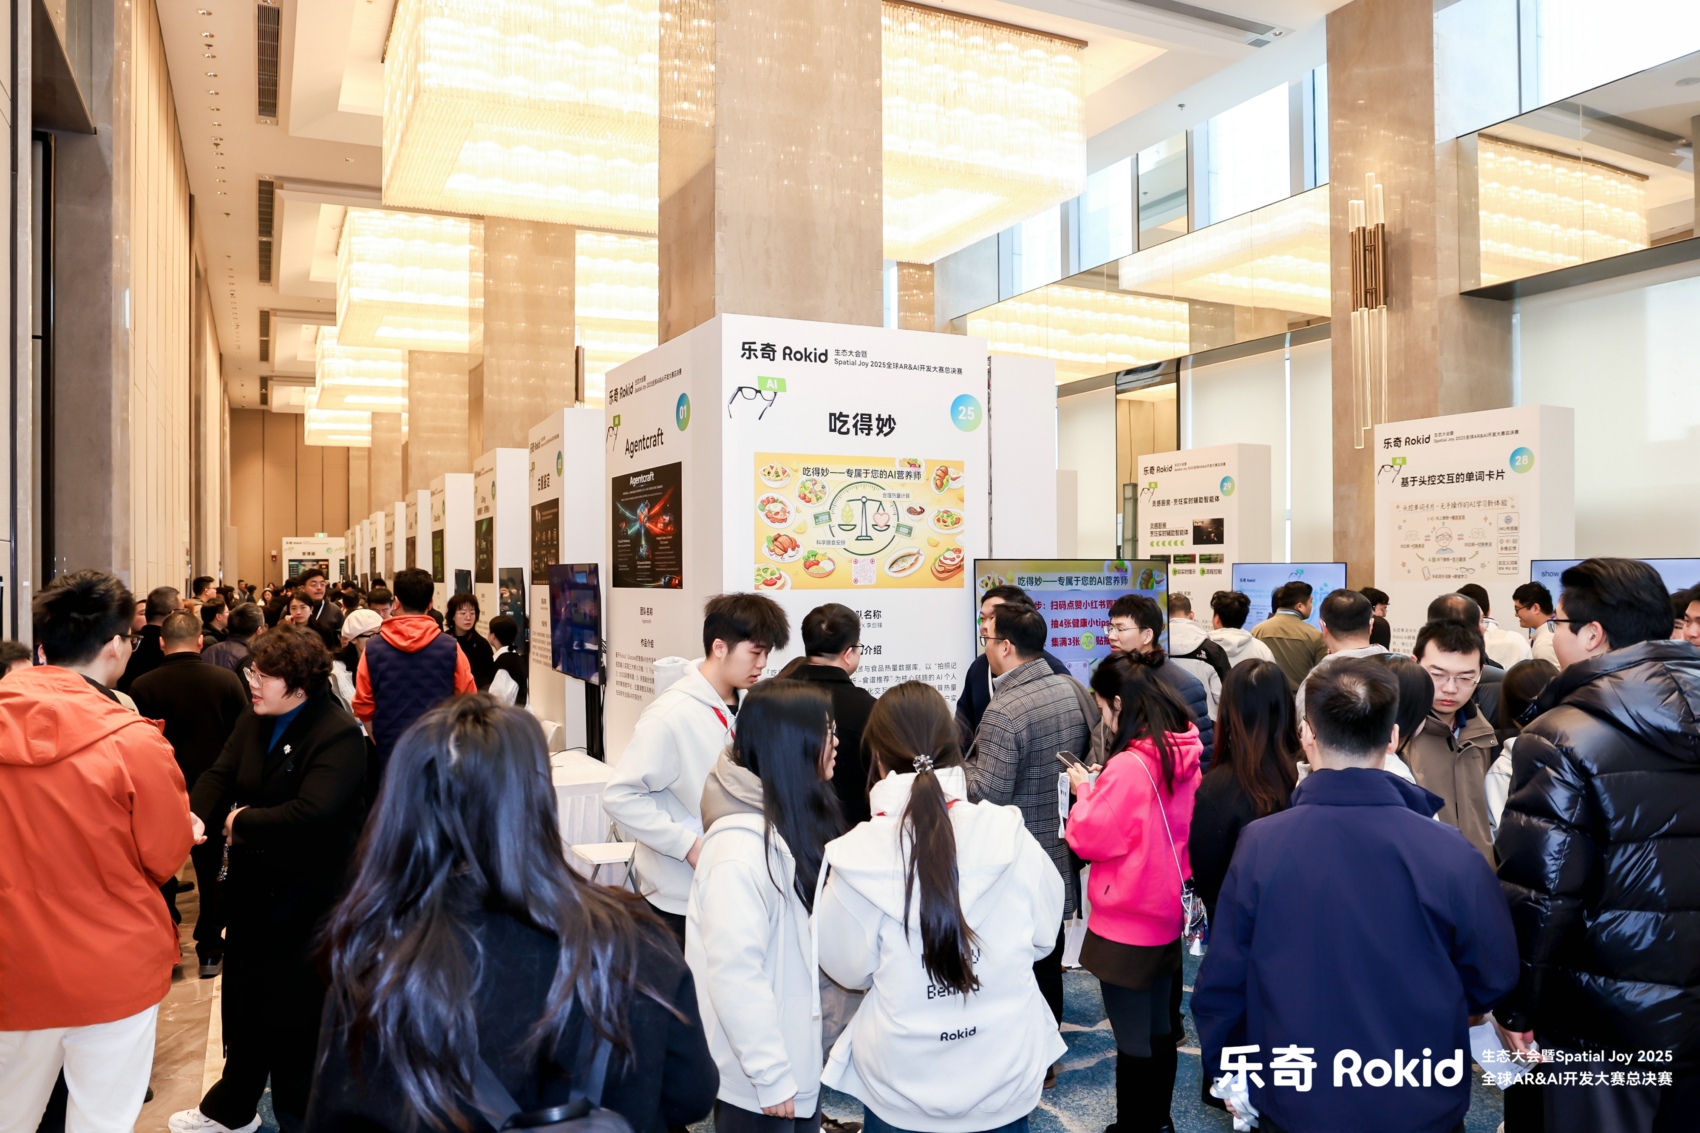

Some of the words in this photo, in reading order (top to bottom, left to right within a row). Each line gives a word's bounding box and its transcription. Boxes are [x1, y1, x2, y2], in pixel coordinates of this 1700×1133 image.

[741, 342, 776, 361] 乐奇
[782, 345, 829, 363] Rokid
[834, 358, 857, 367] Spatial
[858, 360, 869, 368] Joy
[766, 378, 778, 389] AI
[619, 382, 634, 400] Rokid
[680, 405, 687, 419] 01
[958, 405, 975, 421] 25
[828, 411, 897, 437] 吃得妙
[625, 427, 664, 459] Agentcraft
[1383, 437, 1402, 450] 乐奇
[1404, 434, 1431, 447] Rokid
[1515, 455, 1529, 466] 28
[802, 467, 922, 480] 吃得妙——专属于您的AI营养师
[1156, 464, 1173, 474] Rokid
[629, 471, 655, 487] Agentcraft
[1400, 469, 1506, 488] 基于头控交互的单词卡片
[1223, 482, 1232, 491] 29
[1017, 576, 1129, 587] 吃得妙——专属于您的AI营养师
[856, 610, 882, 620] 队名称
[940, 1026, 977, 1041] Rokid
